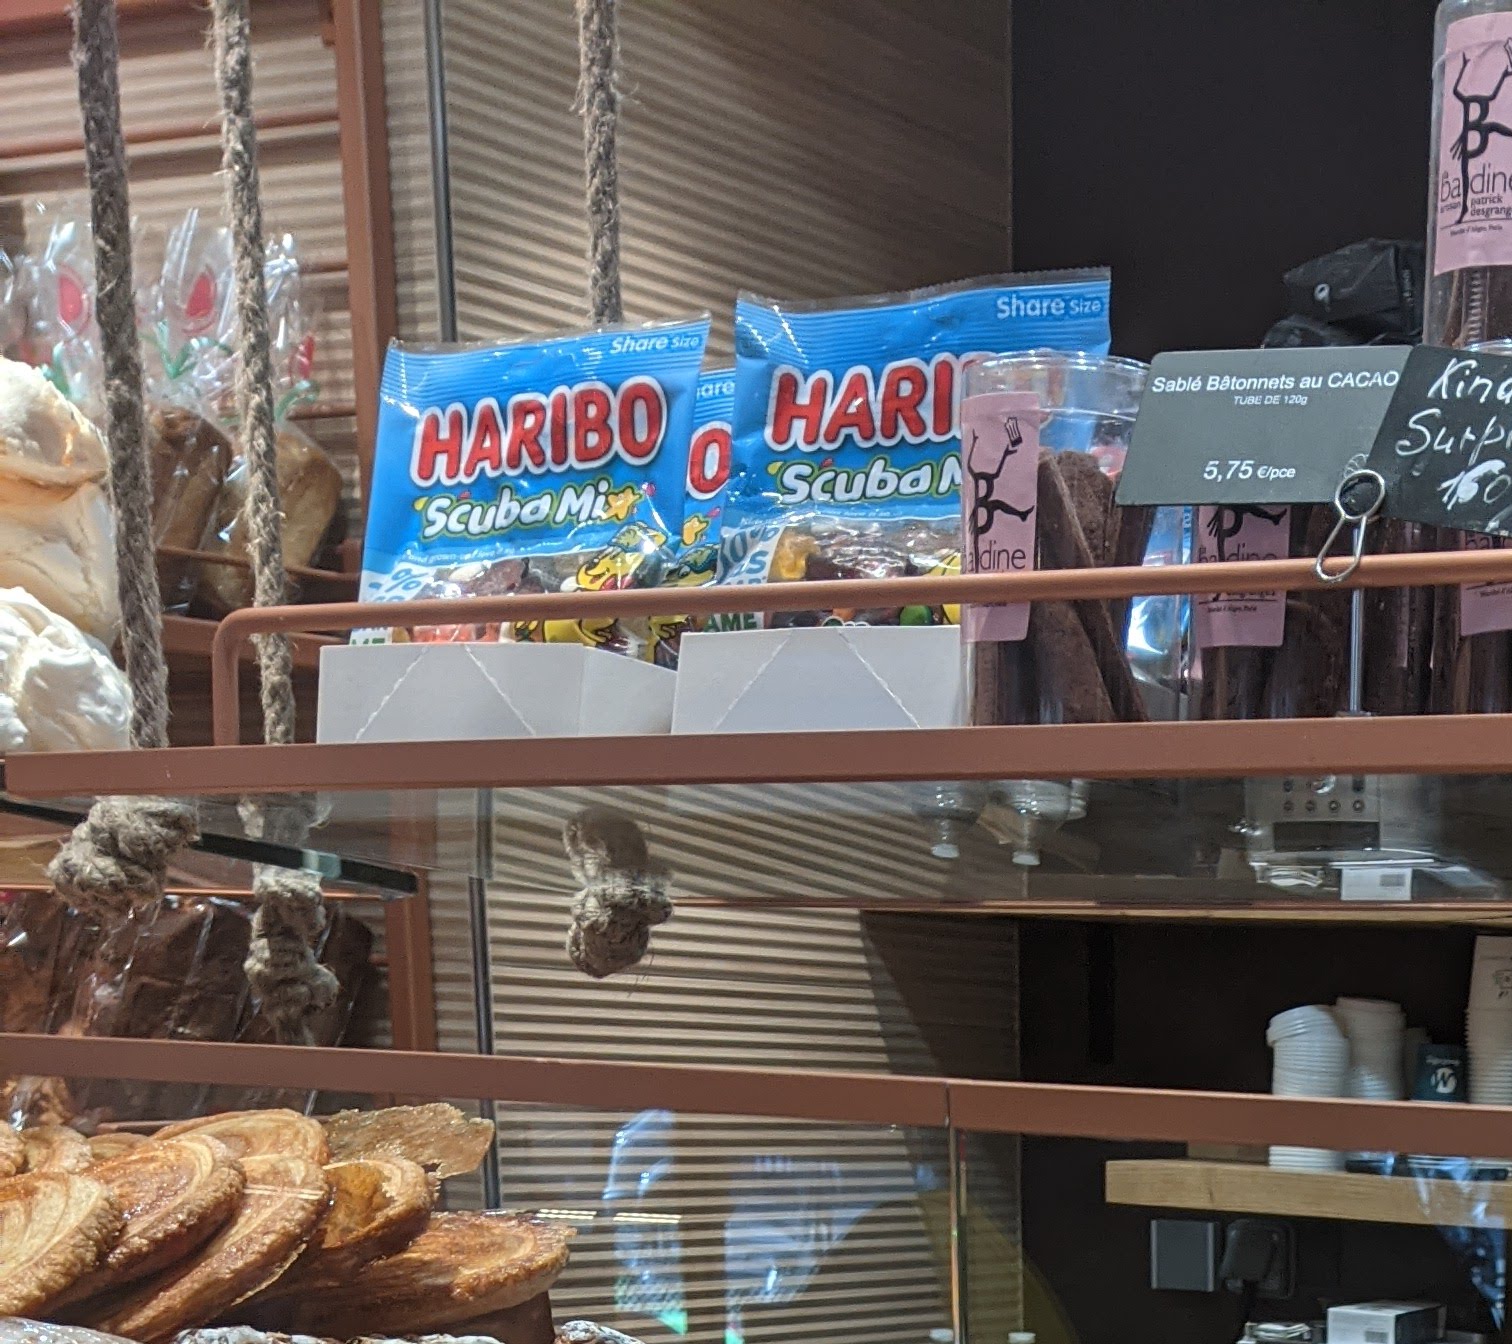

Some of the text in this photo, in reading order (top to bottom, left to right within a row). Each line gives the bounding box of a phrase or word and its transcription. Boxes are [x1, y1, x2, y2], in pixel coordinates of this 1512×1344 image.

[1471, 194, 1503, 208] patrick
[996, 294, 1066, 319] Share
[610, 336, 669, 354] Share
[697, 381, 735, 399] are
[1151, 371, 1400, 392] Sablé Bâtonnets au CACAO
[766, 352, 963, 451] HARI
[1233, 395, 1308, 406] TUBE DE 120g
[412, 376, 667, 486] HARIBO
[776, 457, 932, 506] Scuba
[1203, 460, 1296, 483] 5,75 €/pce
[422, 488, 552, 541] Scuba
[703, 612, 757, 632] AME
